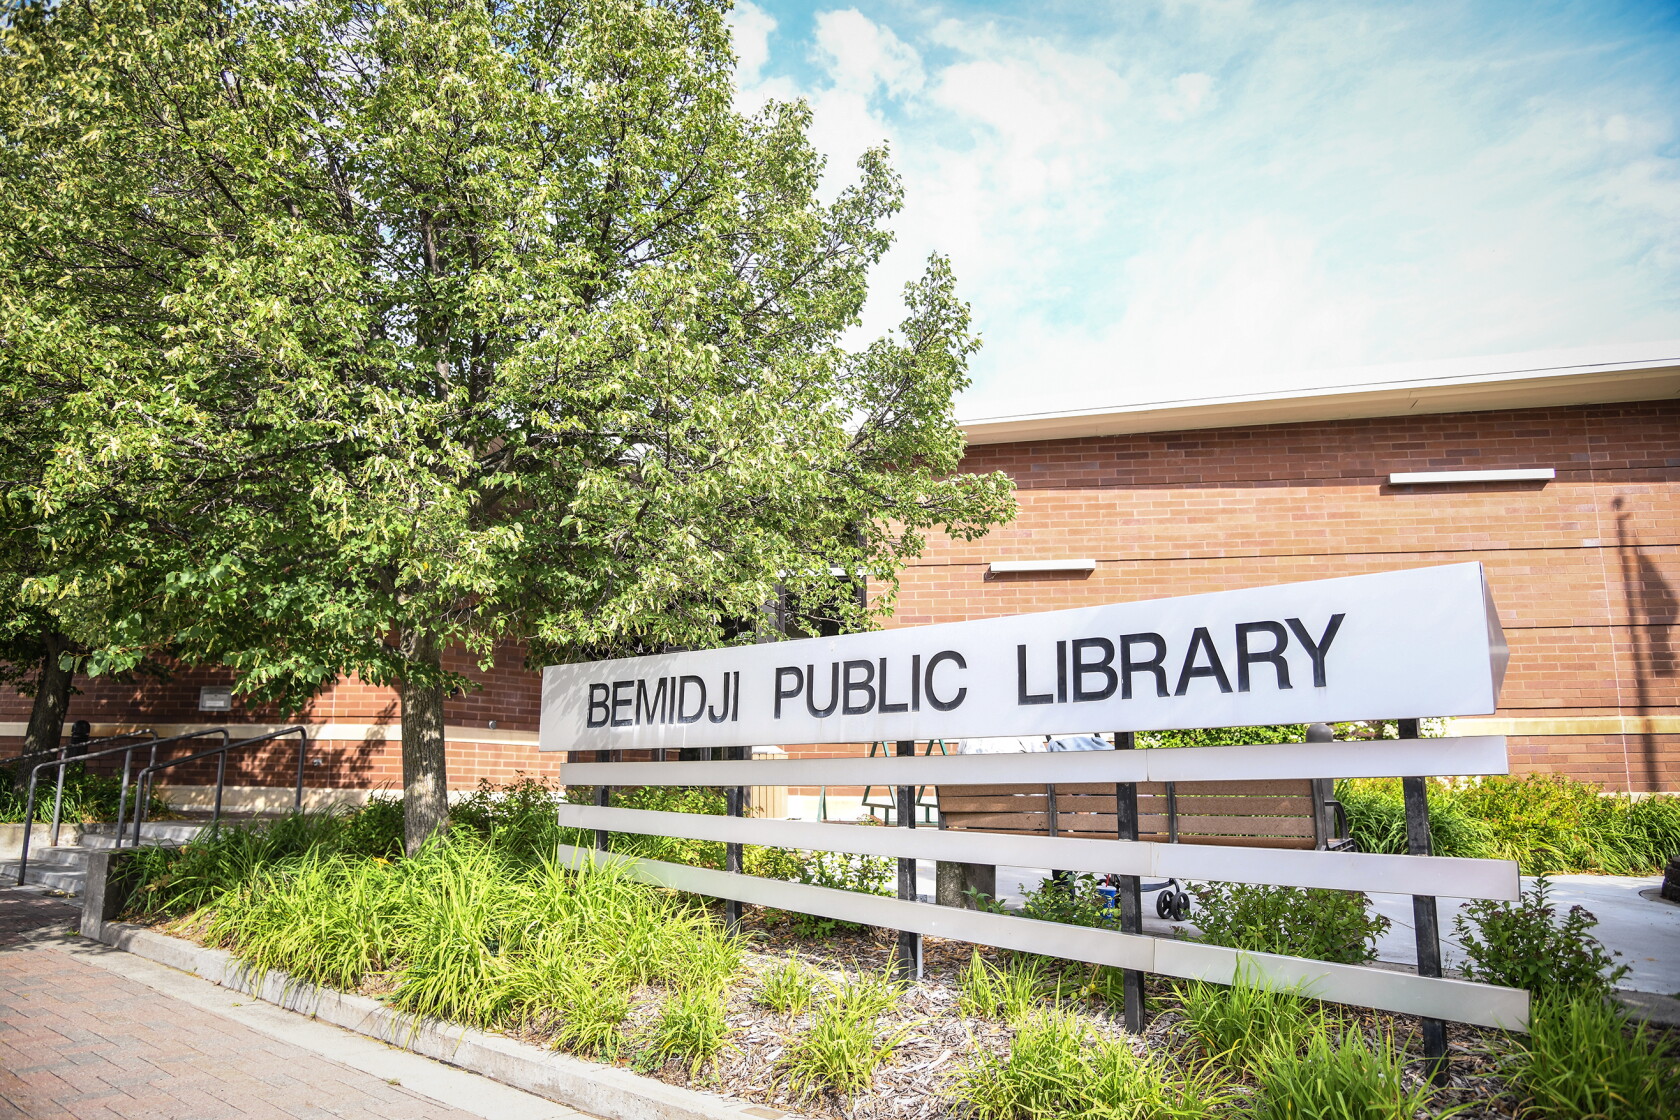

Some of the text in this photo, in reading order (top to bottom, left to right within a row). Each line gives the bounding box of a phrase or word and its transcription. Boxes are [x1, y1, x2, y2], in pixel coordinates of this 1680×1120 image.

[587, 613, 1346, 729] BEMIDJI PUBLIC LIBRARY
